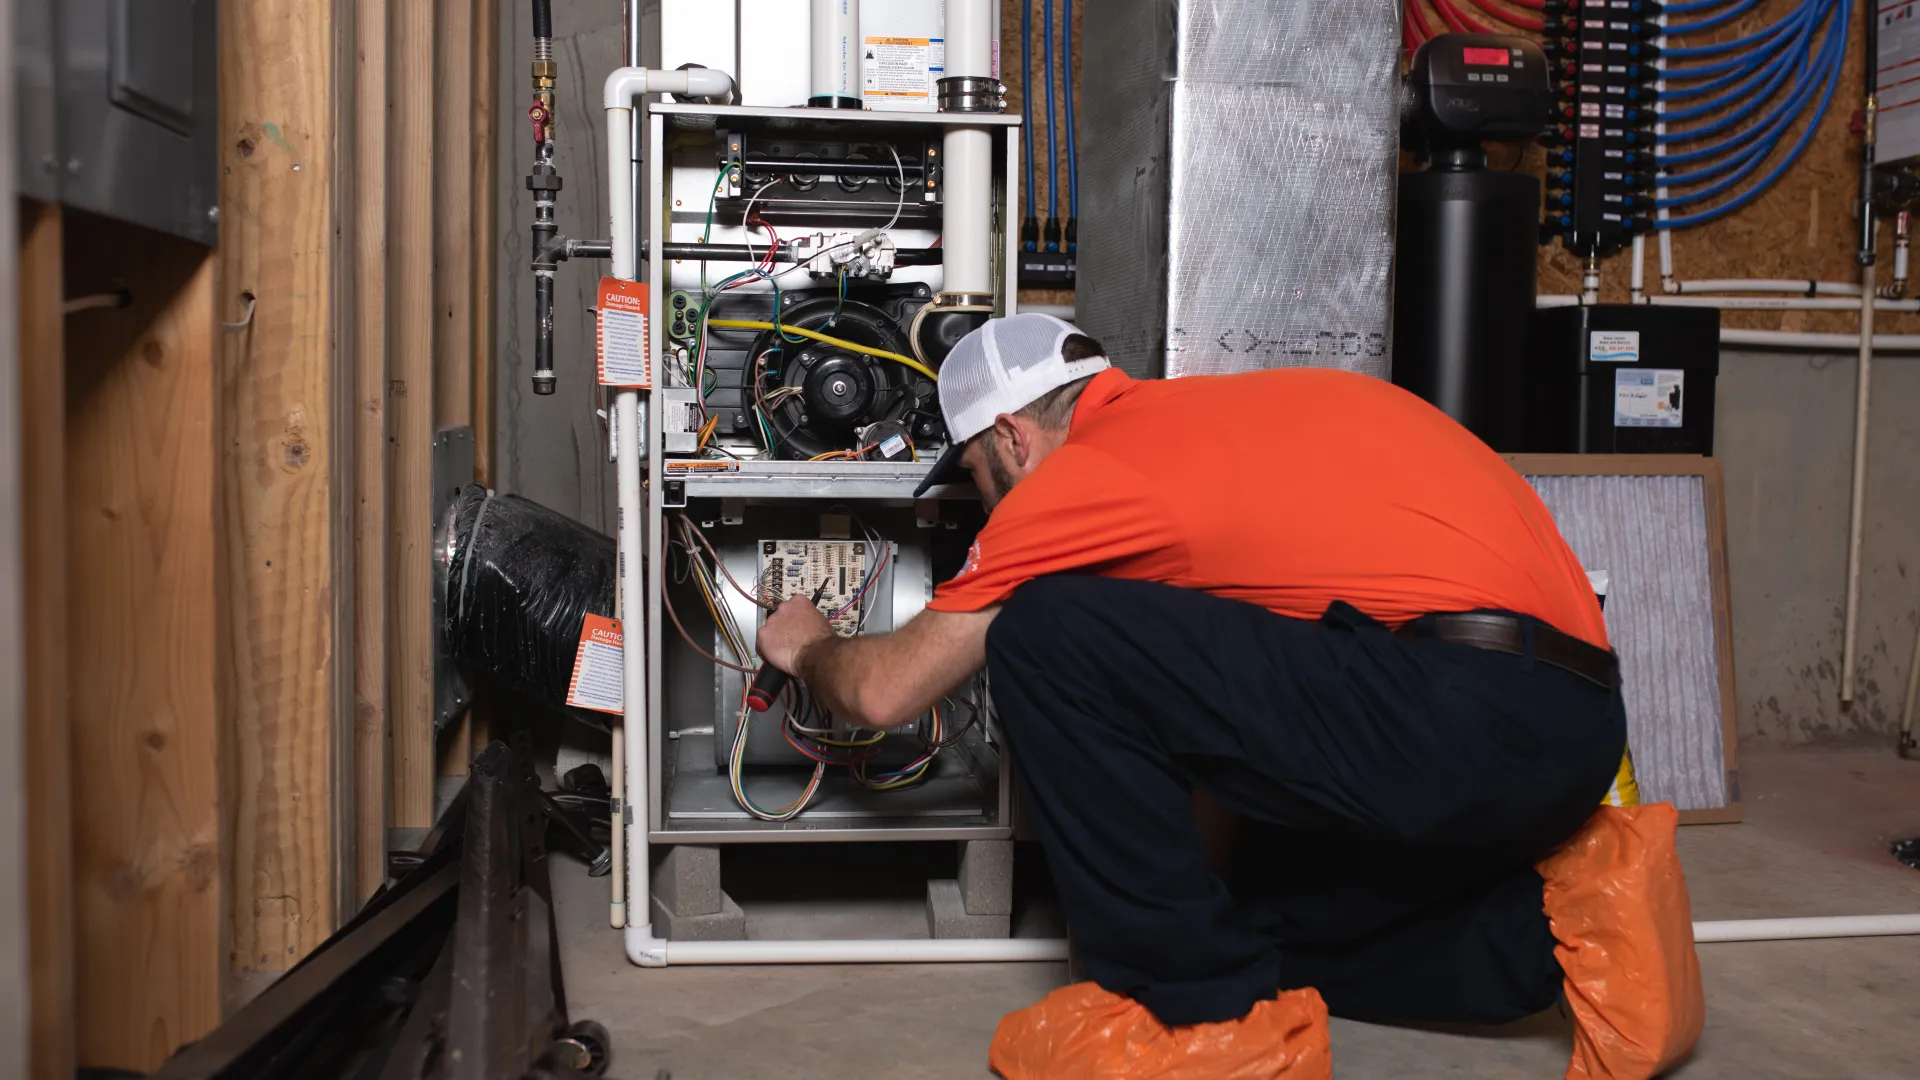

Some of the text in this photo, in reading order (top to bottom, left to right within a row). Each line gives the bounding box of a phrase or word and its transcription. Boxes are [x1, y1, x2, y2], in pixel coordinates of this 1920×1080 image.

[606, 293, 640, 306] CAUTION:
[591, 634, 612, 644] Damage
[592, 628, 622, 640] CAUTIO
